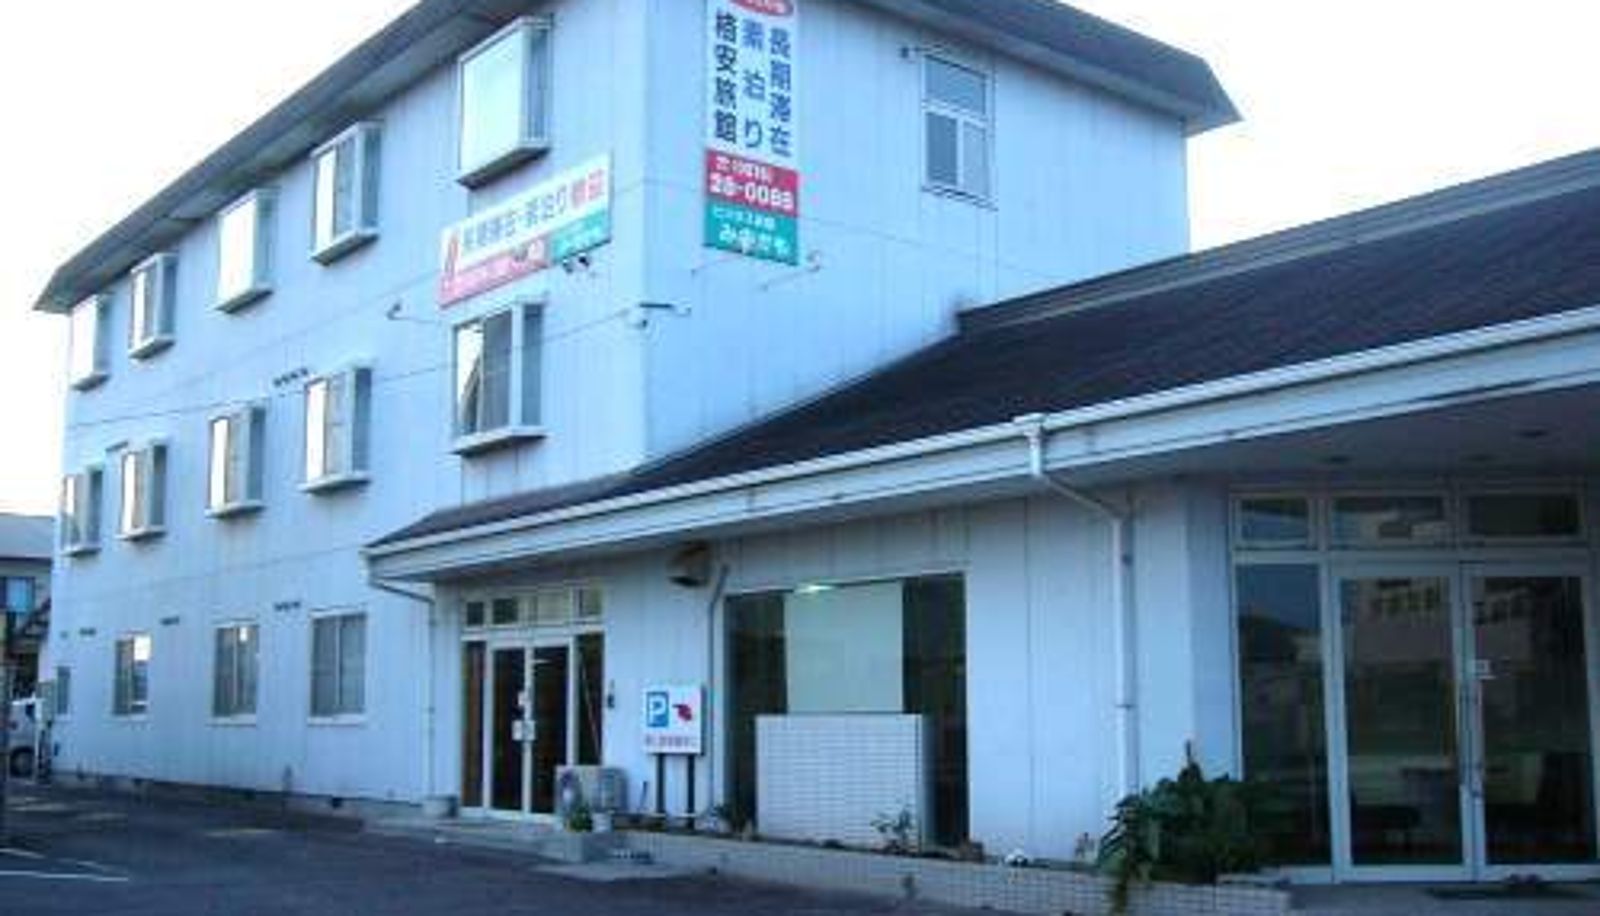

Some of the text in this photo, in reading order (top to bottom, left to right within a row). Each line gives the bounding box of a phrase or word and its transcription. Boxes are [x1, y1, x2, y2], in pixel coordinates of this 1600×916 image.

[714, 9, 738, 145] 格安旅館
[742, 18, 766, 149] 素泊り
[769, 27, 792, 158] 長期滞在
[648, 694, 667, 726] P
